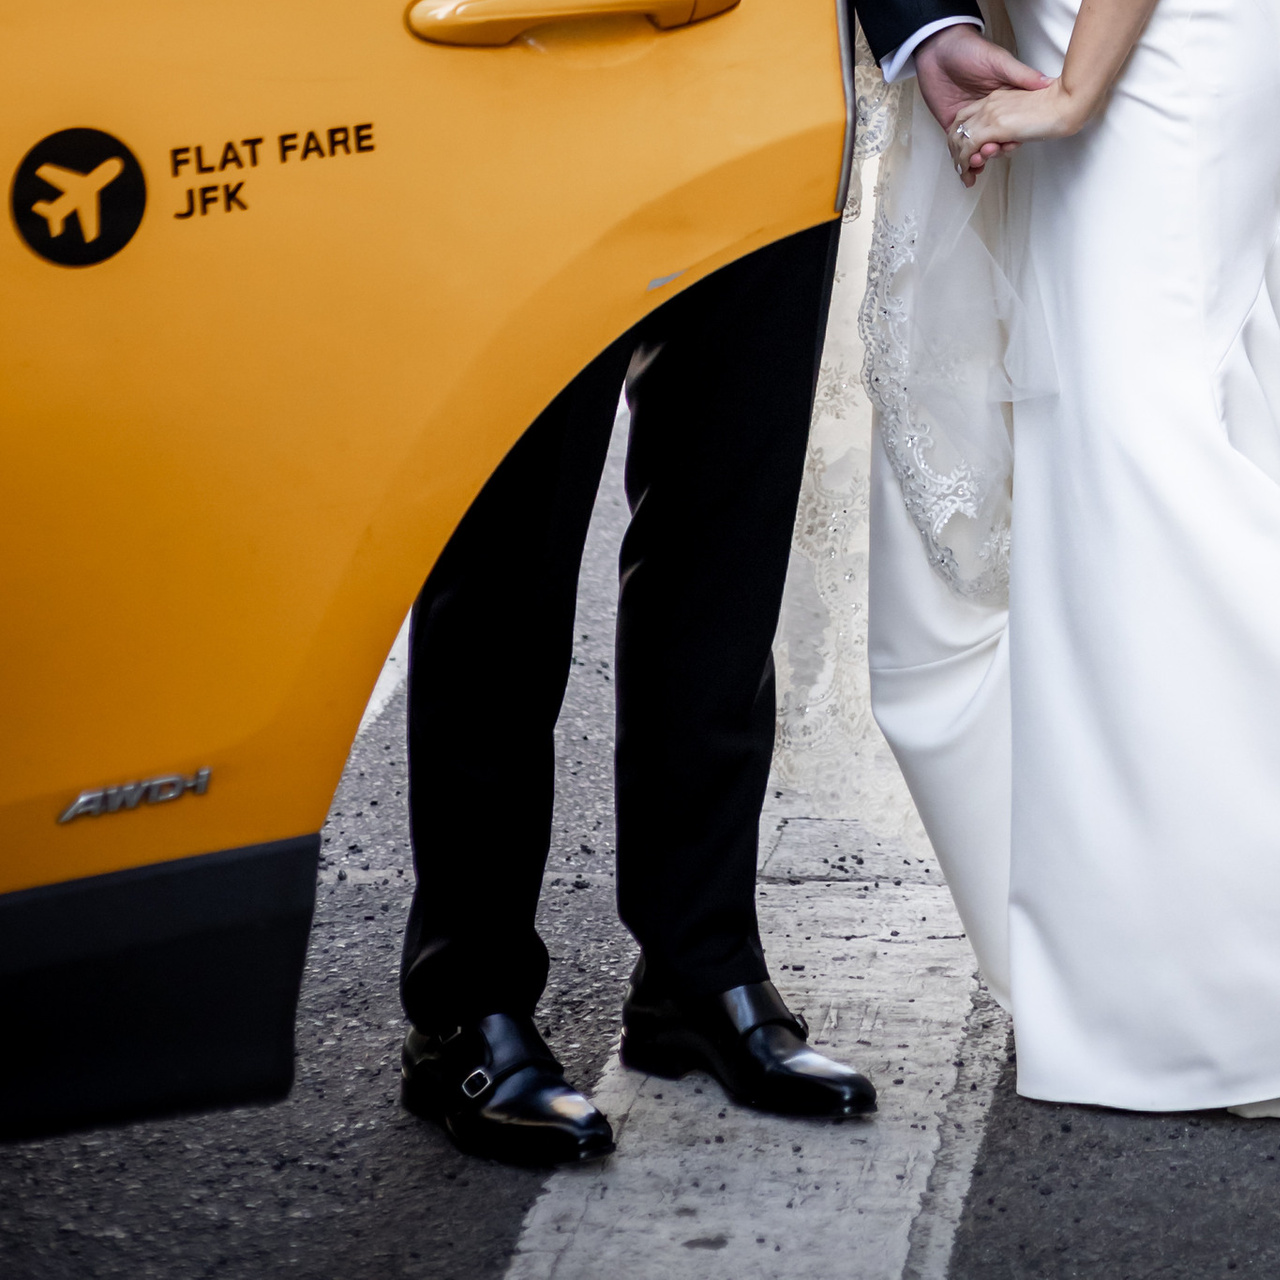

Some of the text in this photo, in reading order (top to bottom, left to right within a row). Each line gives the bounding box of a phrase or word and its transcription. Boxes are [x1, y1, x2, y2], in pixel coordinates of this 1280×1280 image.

[170, 123, 375, 178] FLAT FARE
[173, 182, 249, 220] JFK
